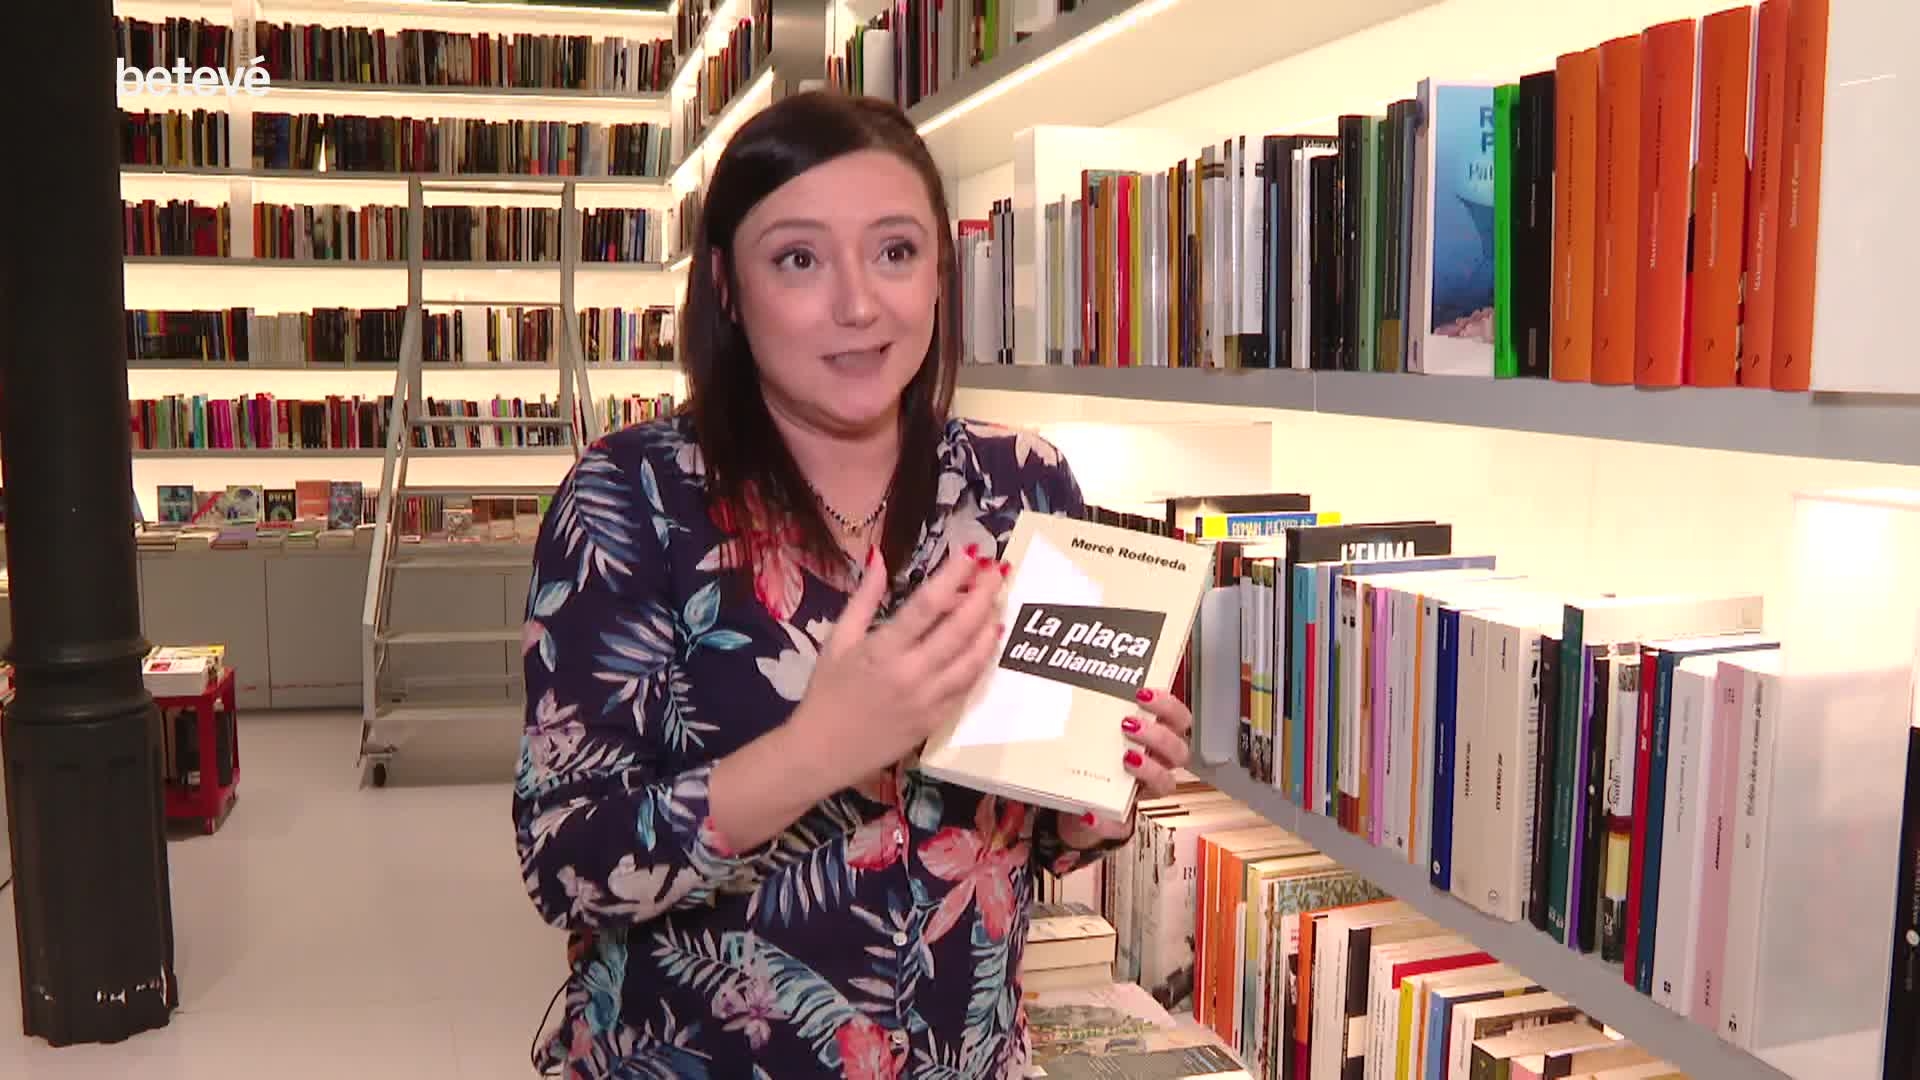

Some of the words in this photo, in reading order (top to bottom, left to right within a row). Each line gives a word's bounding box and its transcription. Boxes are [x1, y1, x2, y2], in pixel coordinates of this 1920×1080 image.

[1118, 546, 1187, 572] Rodoreda
[1023, 608, 1062, 638] La
[1060, 620, 1151, 658] plaça
[1009, 641, 1049, 663] del
[1047, 646, 1145, 686] Diamant
